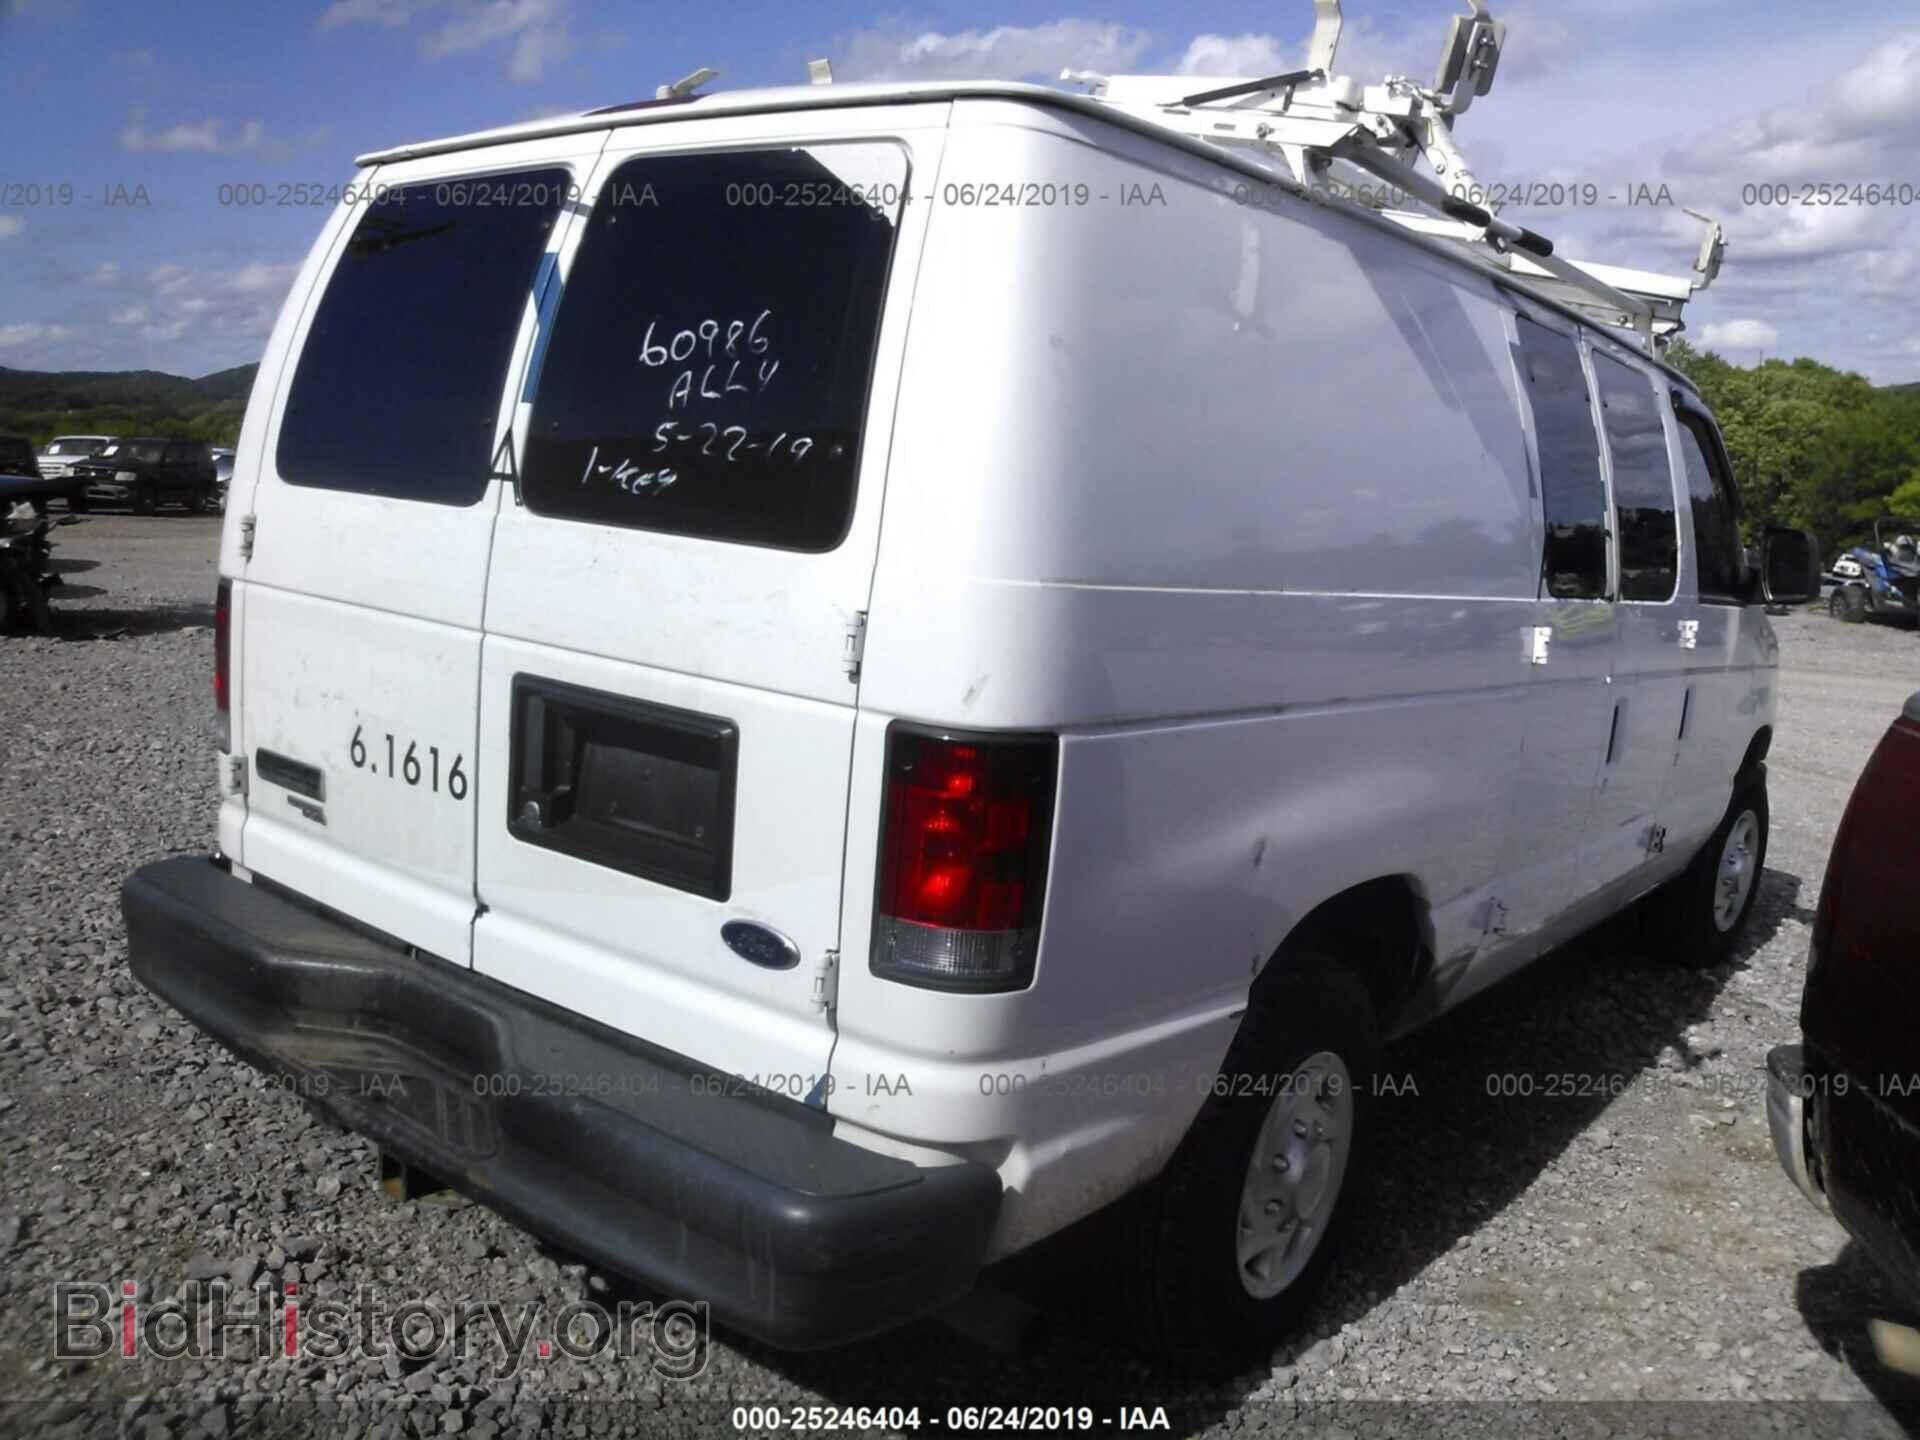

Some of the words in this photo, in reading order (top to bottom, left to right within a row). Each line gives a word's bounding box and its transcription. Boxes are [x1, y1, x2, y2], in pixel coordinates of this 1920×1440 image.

[638, 309, 772, 367] 60986
[652, 421, 814, 461] 5-22-19
[350, 723, 468, 801] 6.1616
